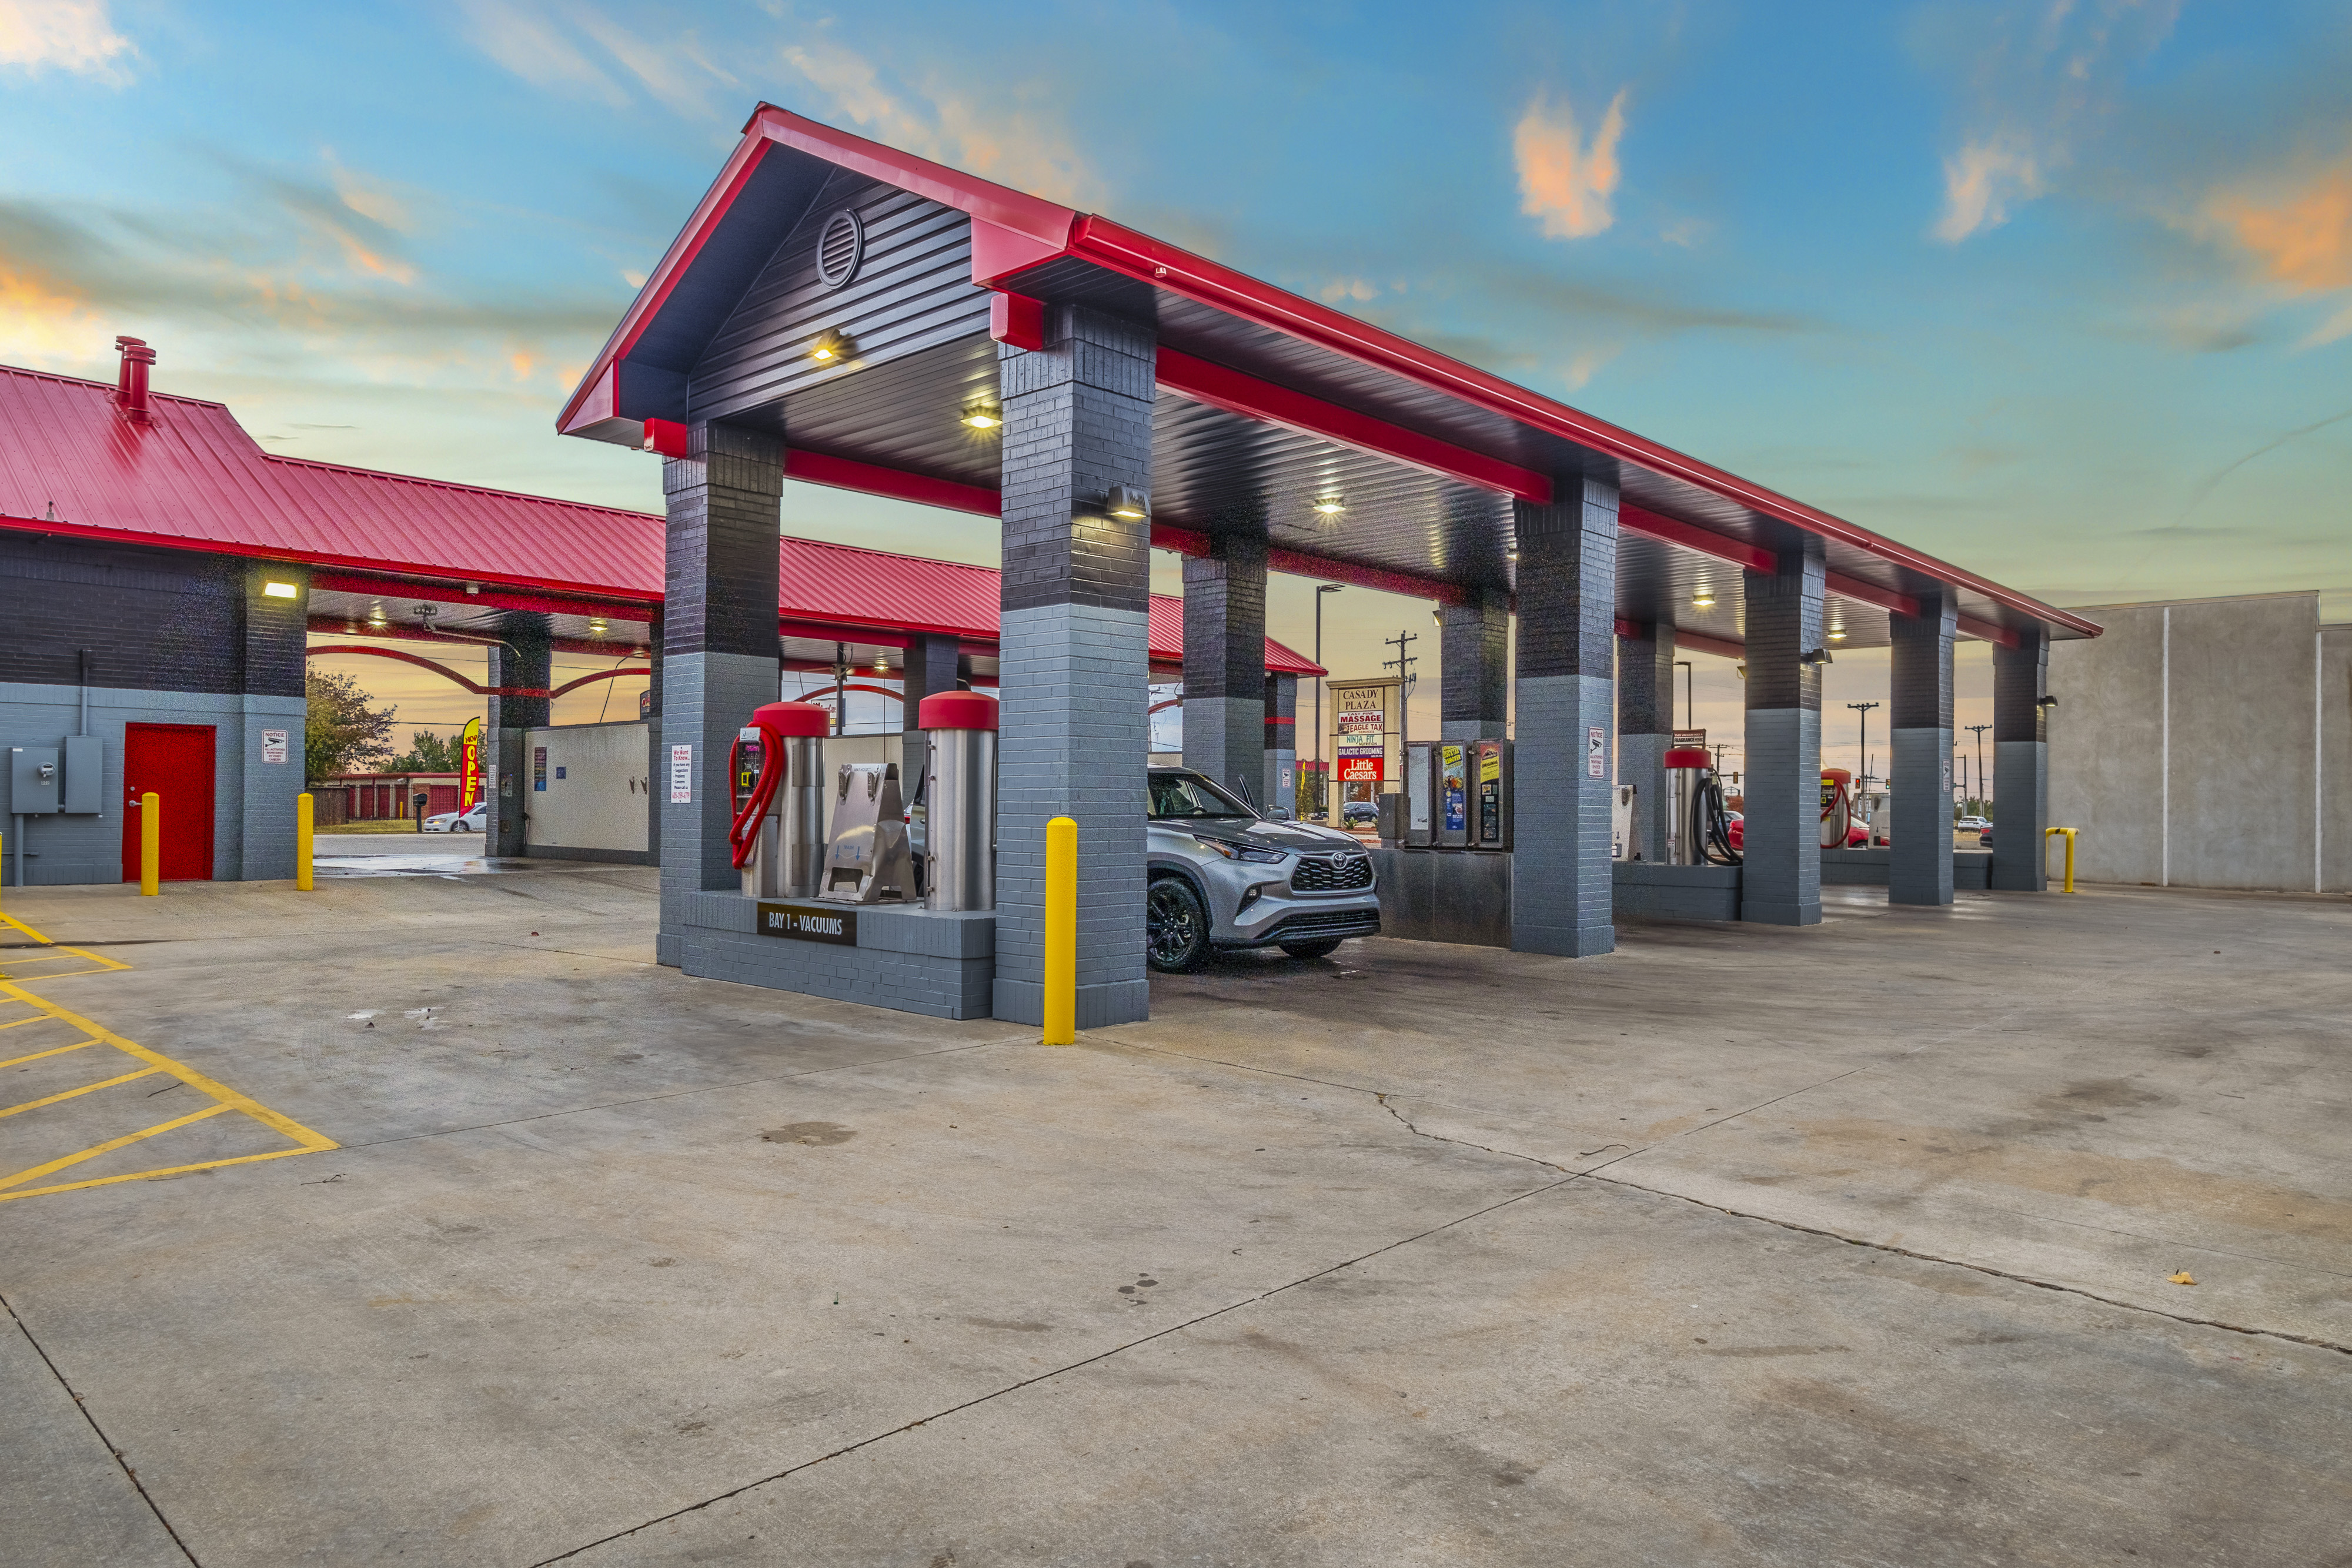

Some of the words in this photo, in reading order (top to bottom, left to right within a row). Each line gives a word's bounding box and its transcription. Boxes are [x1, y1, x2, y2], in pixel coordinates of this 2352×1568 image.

[1343, 689, 1378, 700] CASADY
[1345, 700, 1376, 710] PLAZA
[1350, 724, 1368, 733] EAGLE
[1347, 735, 1363, 744] NINJA
[1350, 759, 1374, 770] Little
[464, 745, 477, 807] OPEN
[1344, 768, 1377, 780] Caesars
[769, 912, 784, 928] BAY
[787, 914, 790, 929] 1
[799, 915, 842, 935] VACUUMS
